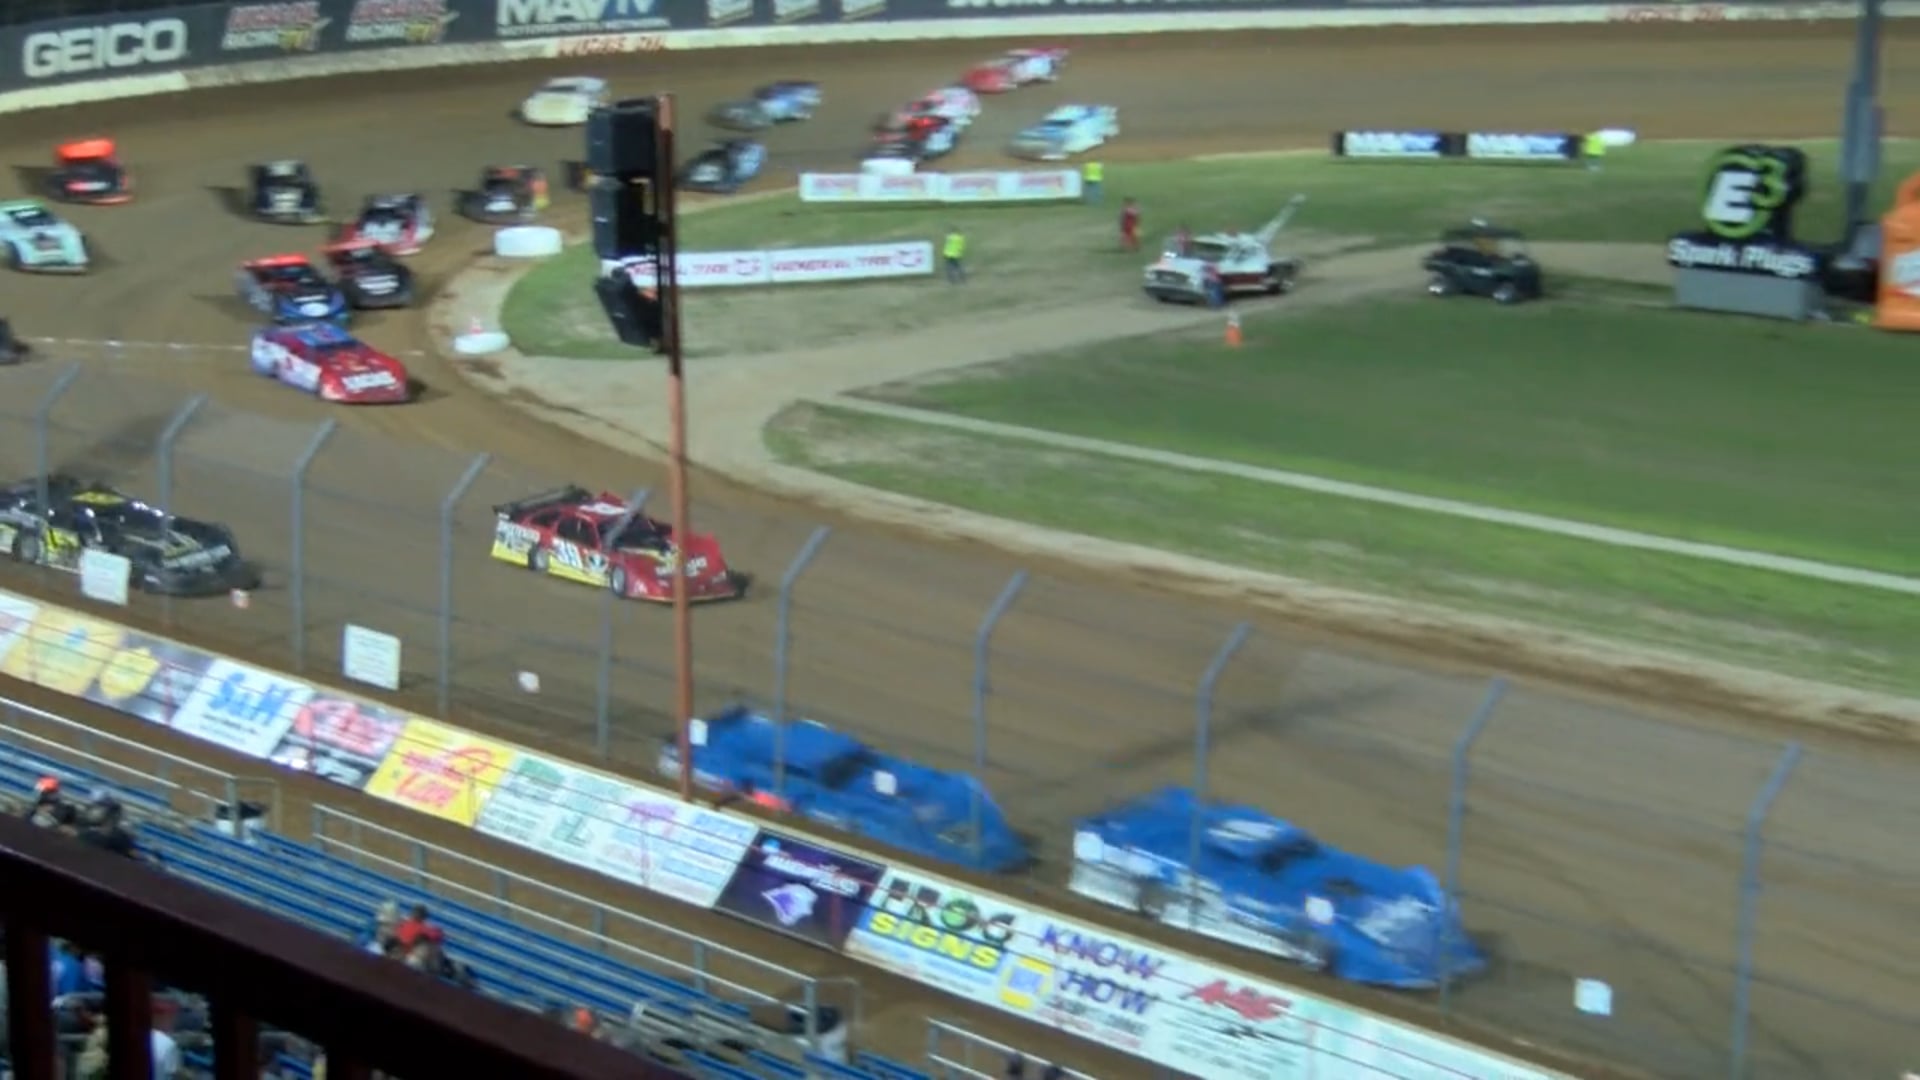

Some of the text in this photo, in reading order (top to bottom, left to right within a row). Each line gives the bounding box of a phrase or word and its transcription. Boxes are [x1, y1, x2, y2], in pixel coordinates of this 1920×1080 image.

[23, 18, 188, 78] GEICO
[1703, 156, 1788, 223] E3
[1667, 238, 1816, 278] Spark Plugs
[869, 910, 1000, 970] SIGNS
[1038, 925, 1167, 980] KNOW
[1059, 968, 1162, 1016] HOW
